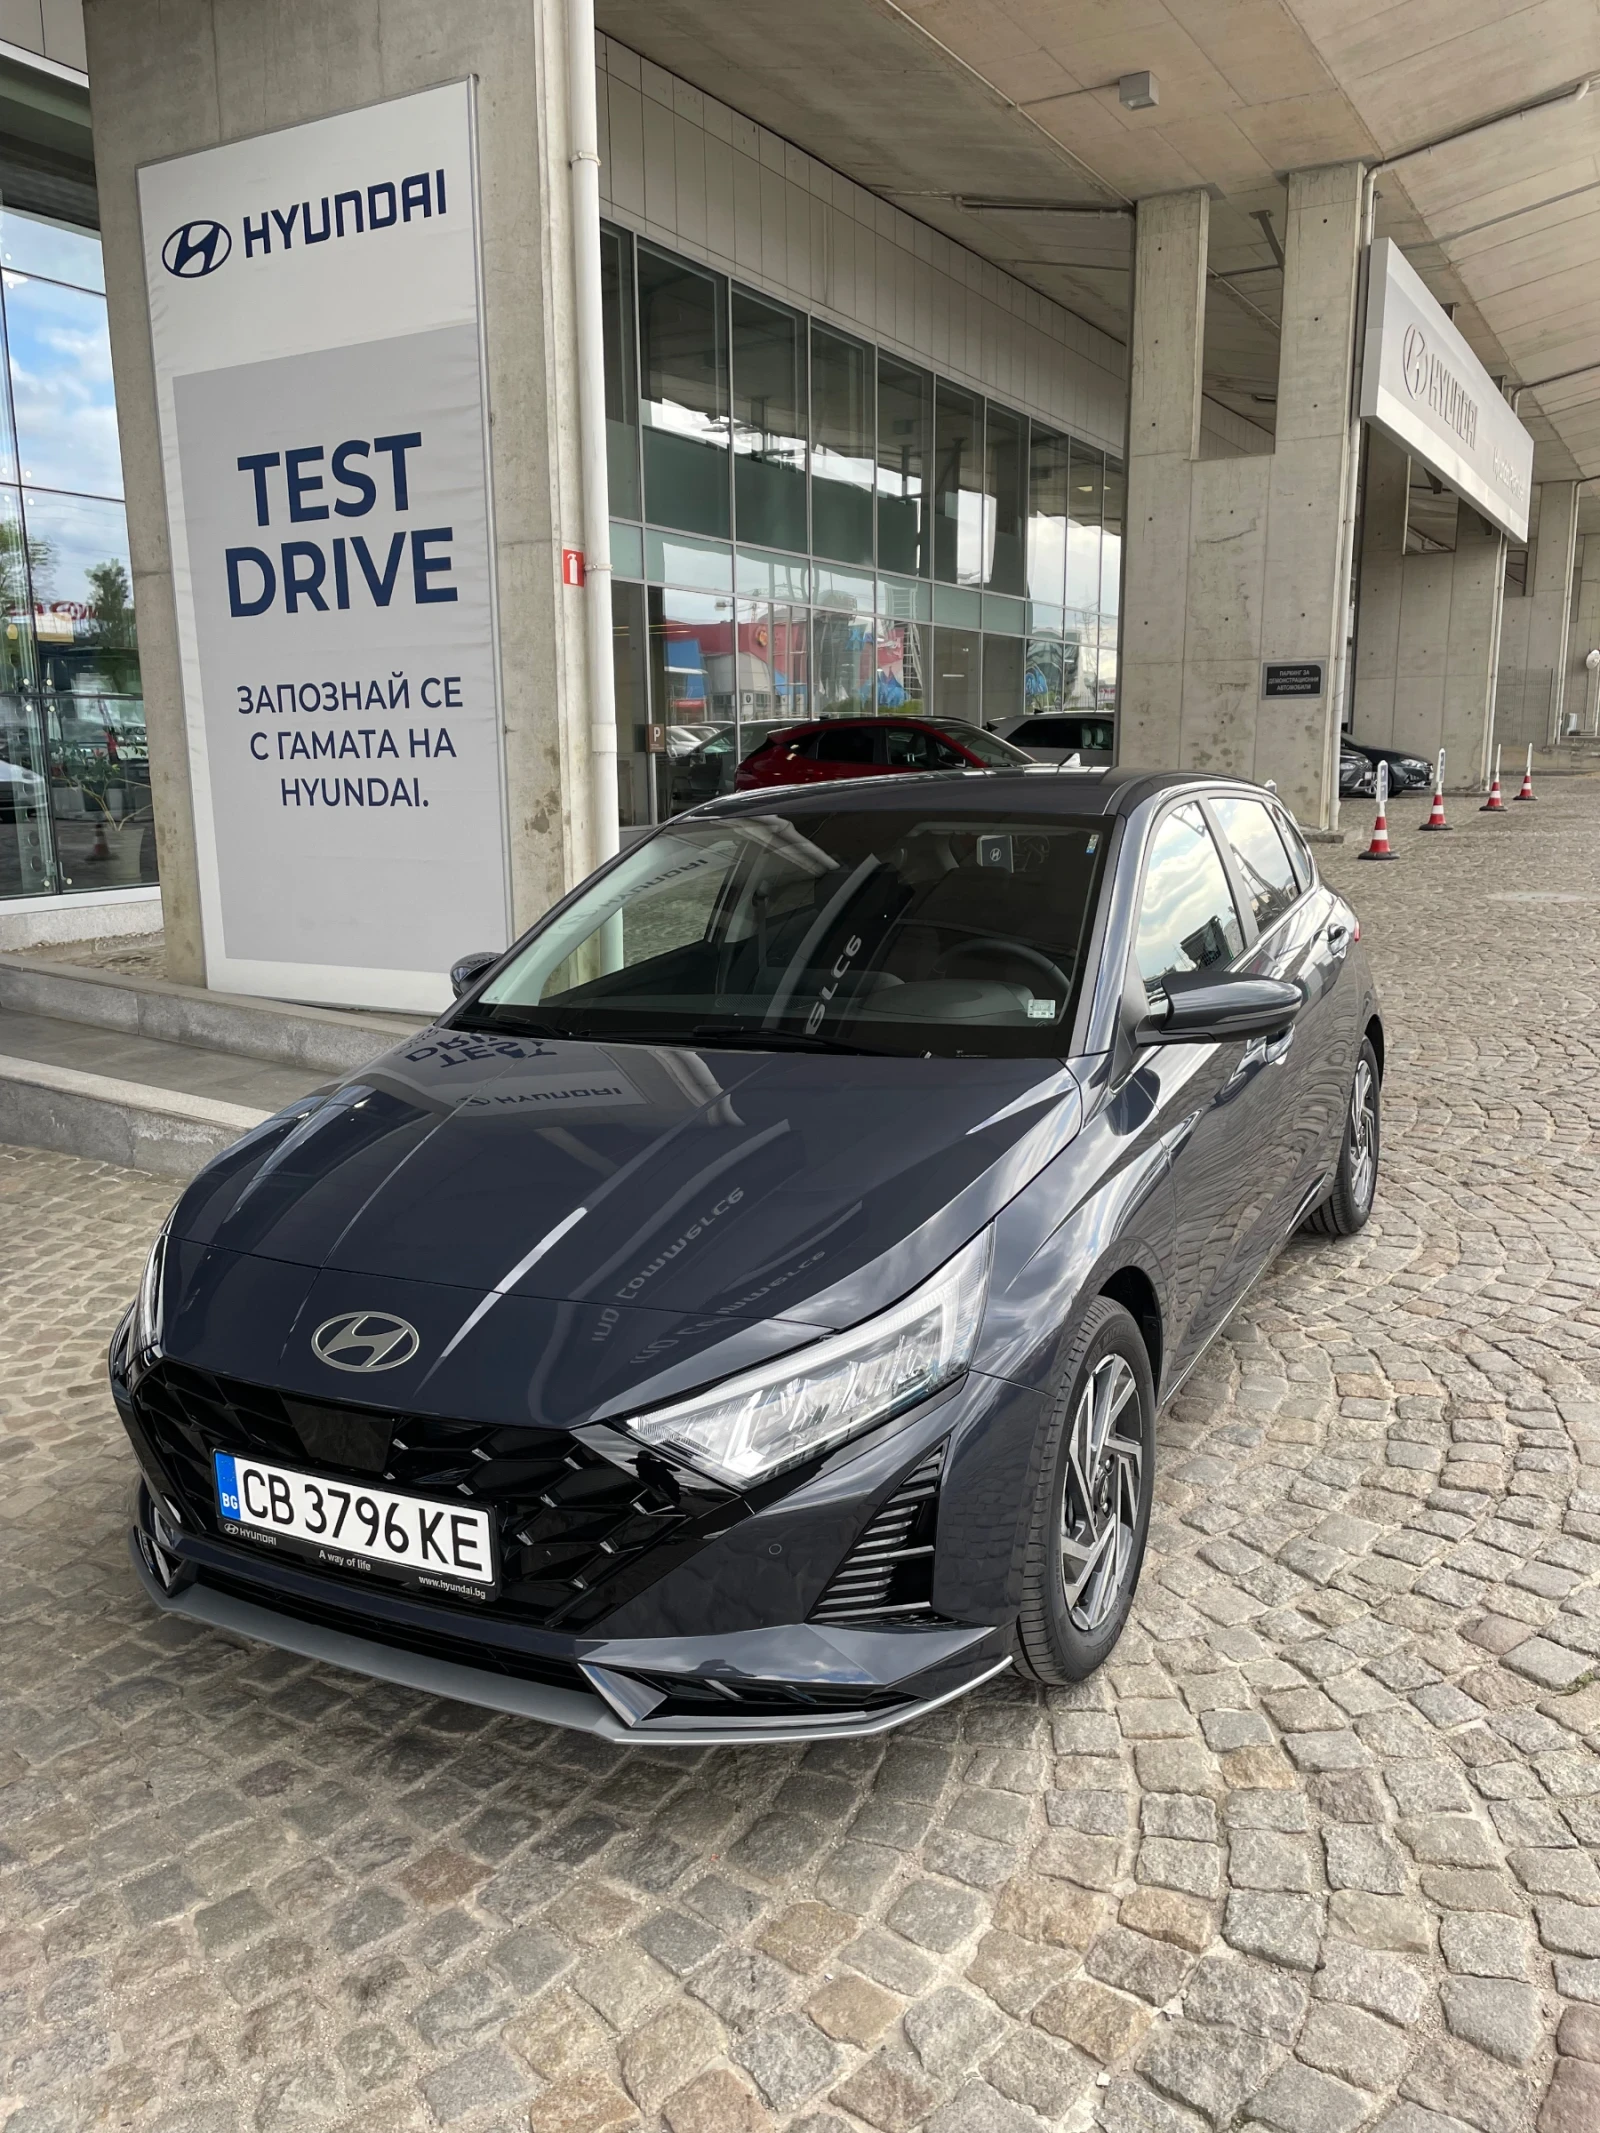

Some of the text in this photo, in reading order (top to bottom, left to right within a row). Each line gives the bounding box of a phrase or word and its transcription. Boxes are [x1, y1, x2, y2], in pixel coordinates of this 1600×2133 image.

[243, 169, 447, 258] HYUNDAI
[1428, 353, 1479, 451] HYUNDAI
[237, 431, 422, 526] TEST
[226, 527, 458, 617] DRIVE
[237, 672, 463, 714] ЗАПОЗНАЙ СЕ
[250, 727, 456, 760] С ГАМАТА НА
[281, 777, 429, 808] HYUNDAI.
[222, 1492, 238, 1510] BG
[239, 1528, 277, 1546] HYUNDAI
[243, 1468, 483, 1572] CB 3796 KE
[318, 1549, 371, 1572] A way of life
[418, 1575, 486, 1600] www.hyundai.bg
